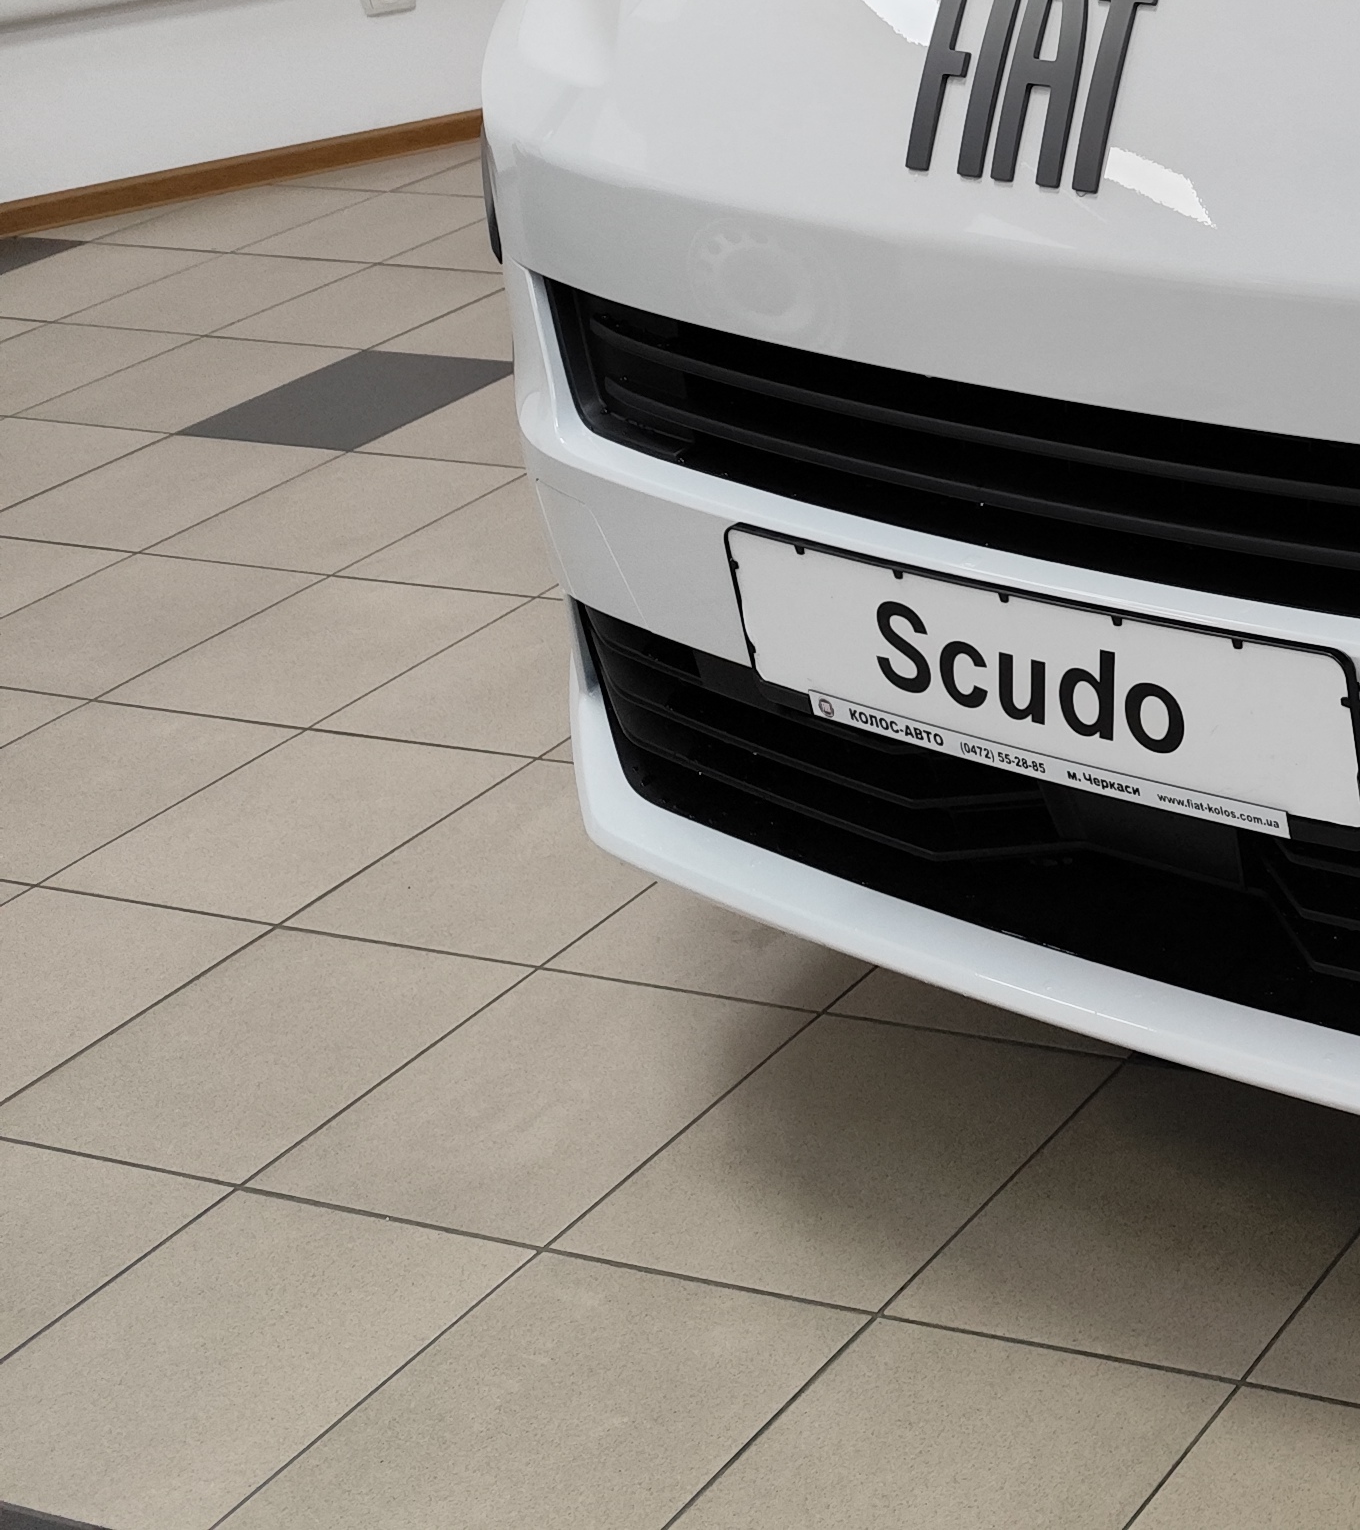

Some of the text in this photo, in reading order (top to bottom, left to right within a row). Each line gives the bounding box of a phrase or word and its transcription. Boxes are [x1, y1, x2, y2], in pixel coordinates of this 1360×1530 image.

[875, 600, 1186, 755] Scudo
[849, 707, 945, 747] КОЛОС-АВТО
[959, 741, 996, 763] (0472)
[997, 751, 1046, 774] 55-28-85
[1156, 793, 1281, 829] www.fiat-kolos.com.ua
